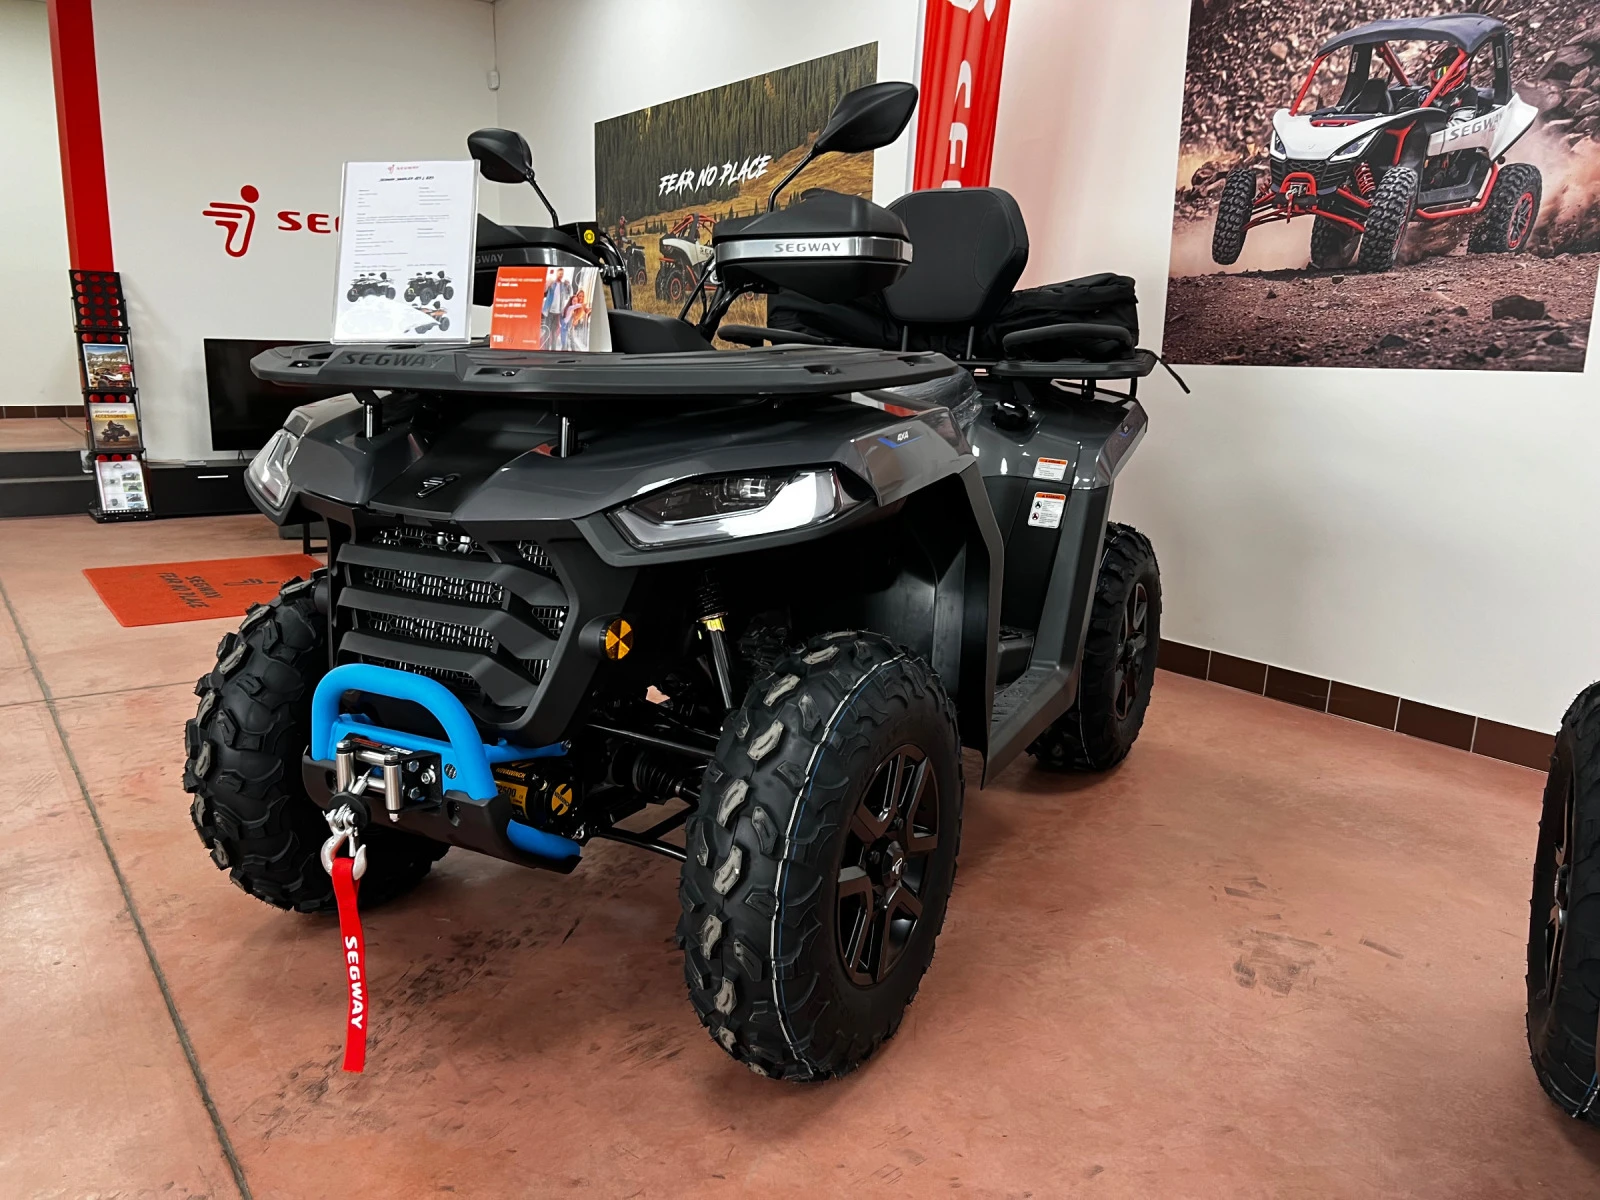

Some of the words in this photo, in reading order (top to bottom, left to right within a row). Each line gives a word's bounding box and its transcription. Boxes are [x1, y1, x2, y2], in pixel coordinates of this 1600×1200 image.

[658, 168, 695, 197] FEAR
[694, 162, 718, 193] NO
[718, 154, 772, 188] PLACE
[277, 211, 339, 233] SE
[774, 242, 841, 253] SEGWAY
[342, 353, 445, 369] SEGWAY
[344, 935, 364, 1030] SEGWAY
